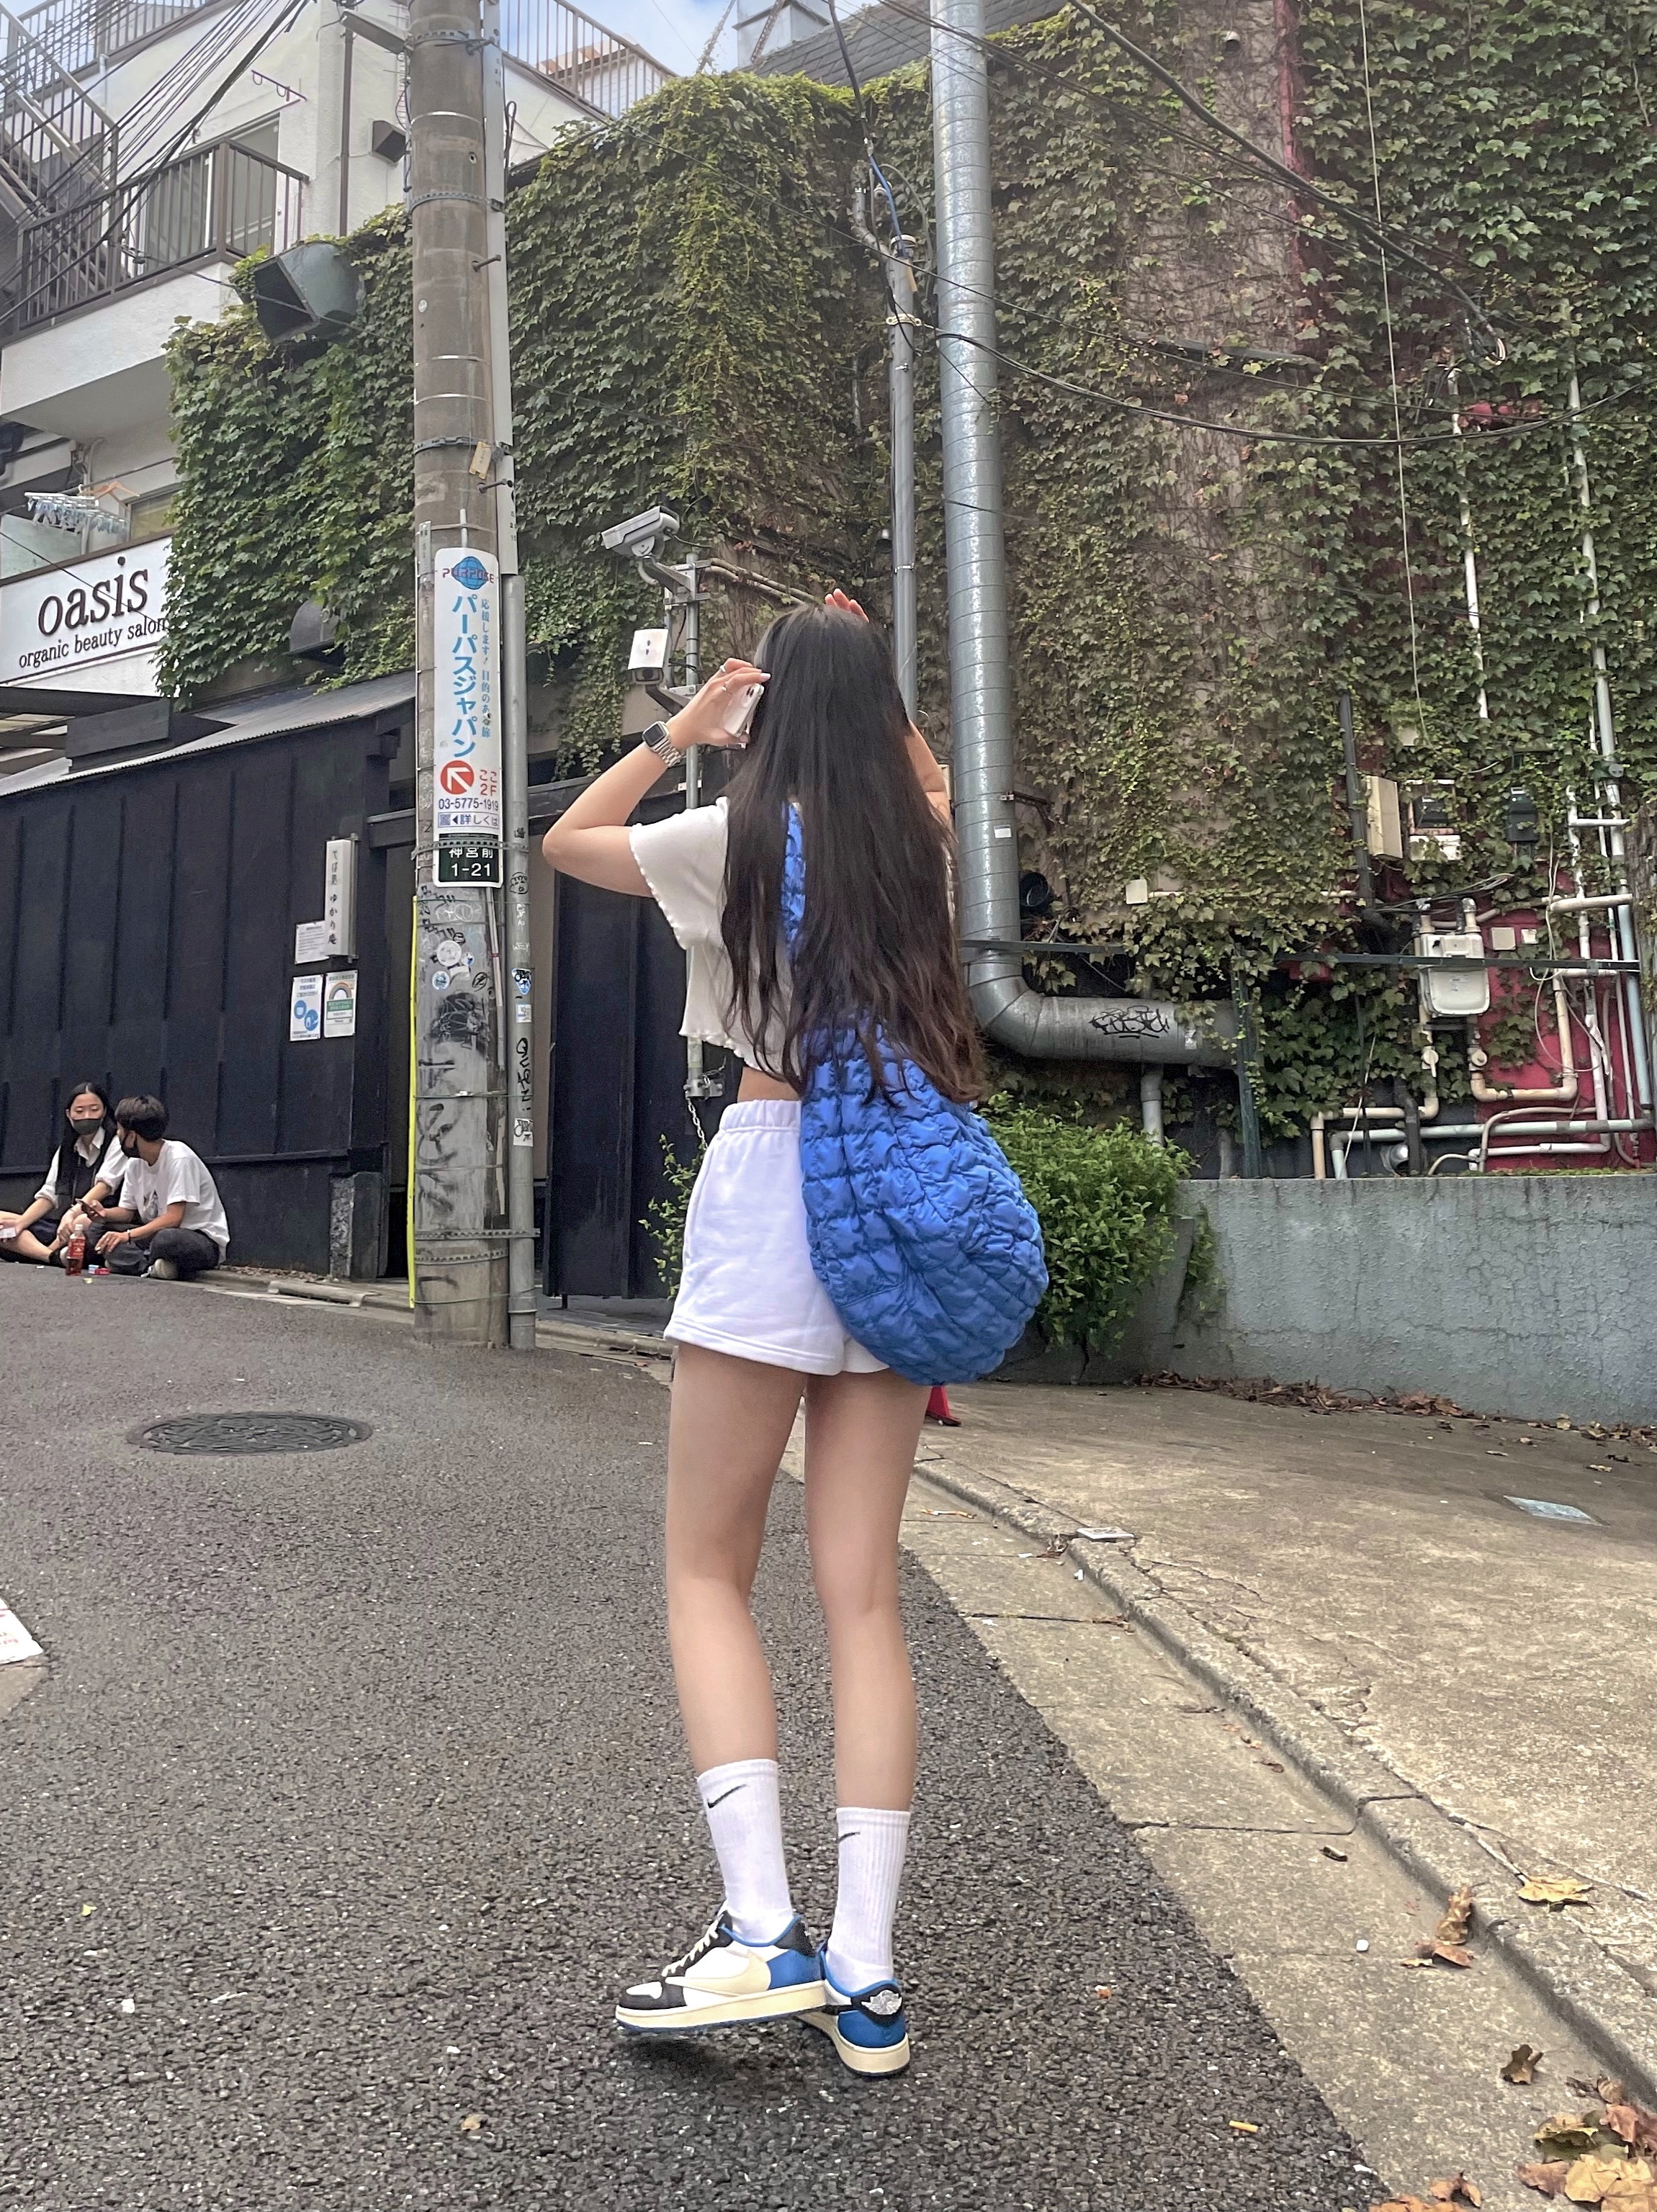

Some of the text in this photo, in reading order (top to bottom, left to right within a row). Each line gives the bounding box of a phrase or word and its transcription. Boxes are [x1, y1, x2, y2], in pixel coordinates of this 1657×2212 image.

[442, 567, 494, 584] PURPOSE
[38, 556, 148, 637] oasis
[19, 616, 166, 668] organic beauty salon
[452, 593, 477, 757] パーパスジャパン
[480, 769, 498, 783] ここ
[480, 783, 497, 796] 2F
[438, 797, 499, 811] 03-5775-1919
[459, 814, 498, 827] 詳しくは
[449, 847, 494, 859] 神宮前
[451, 863, 490, 877] 1-21
